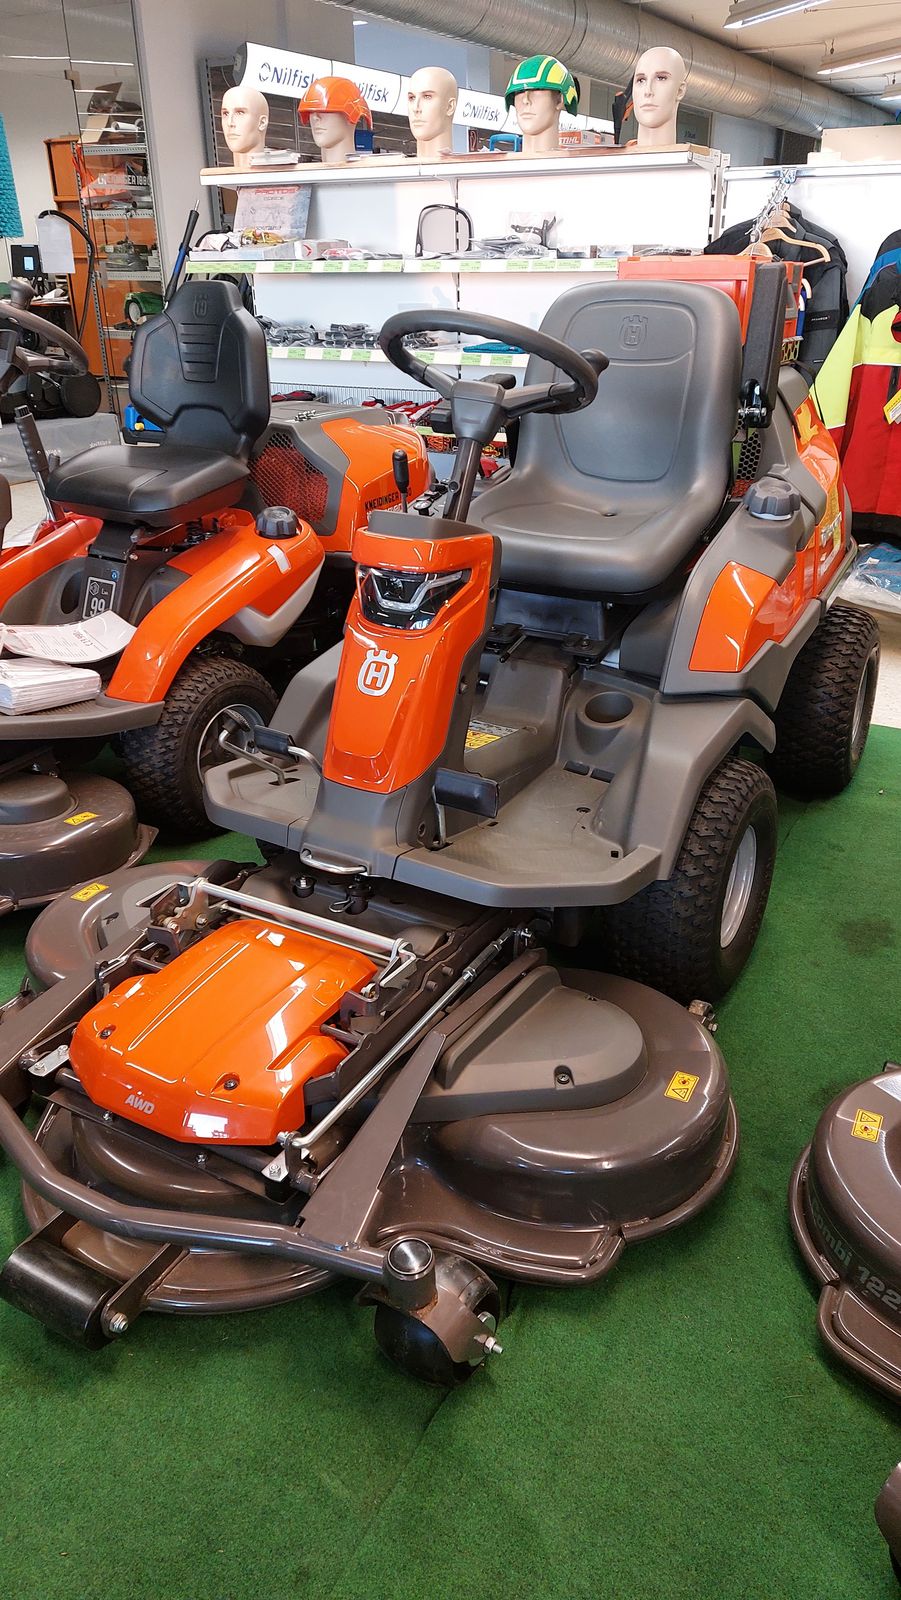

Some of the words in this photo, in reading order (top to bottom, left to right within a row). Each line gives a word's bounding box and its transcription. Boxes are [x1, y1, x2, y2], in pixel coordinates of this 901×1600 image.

[470, 104, 500, 122] Nilfisk
[90, 597, 106, 617] 99
[125, 1094, 155, 1115] AWD
[857, 1266, 901, 1315] 122
